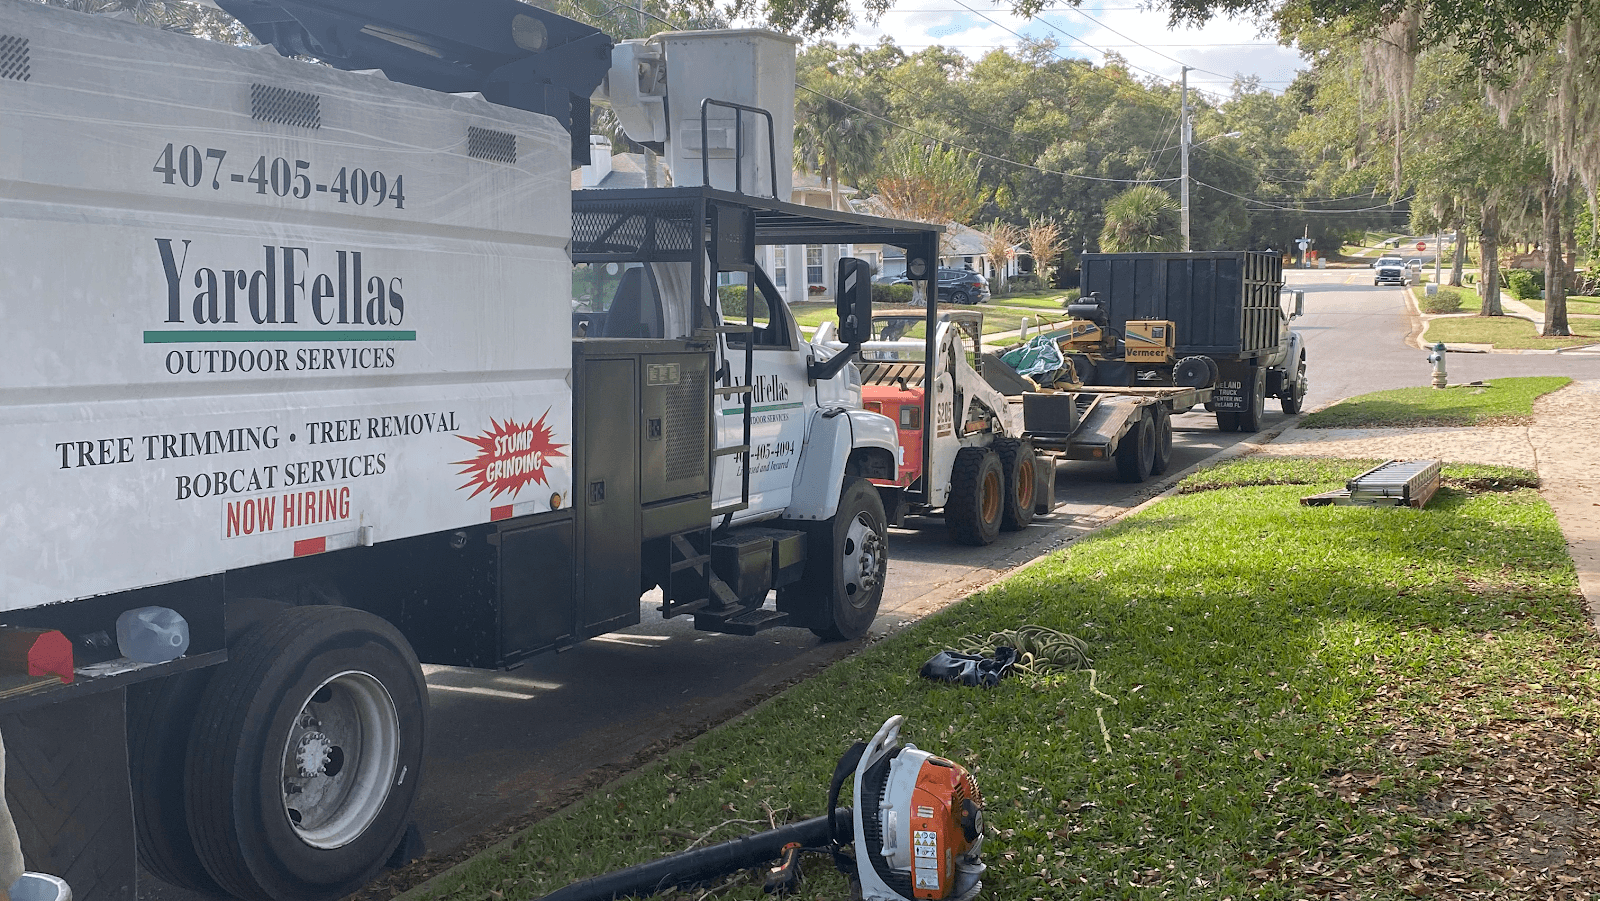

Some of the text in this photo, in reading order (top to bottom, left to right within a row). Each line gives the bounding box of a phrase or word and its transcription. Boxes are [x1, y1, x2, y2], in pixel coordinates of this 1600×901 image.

[153, 143, 405, 209] 407-405-4094
[154, 237, 404, 326] YardFellas
[165, 347, 395, 375] OUTDOOR SERVICES
[1126, 348, 1165, 357] Vermeer
[734, 374, 789, 404] YdFellas
[937, 401, 952, 424] S205
[55, 411, 460, 470] TREE TRIMMING TREE REMOVAL
[494, 429, 534, 458] STUMP
[733, 440, 795, 463] 4-405-4094
[175, 452, 386, 501] BOBCAT SERVICES
[486, 451, 542, 483] GRINDING
[226, 486, 350, 538] NOW HIRING
